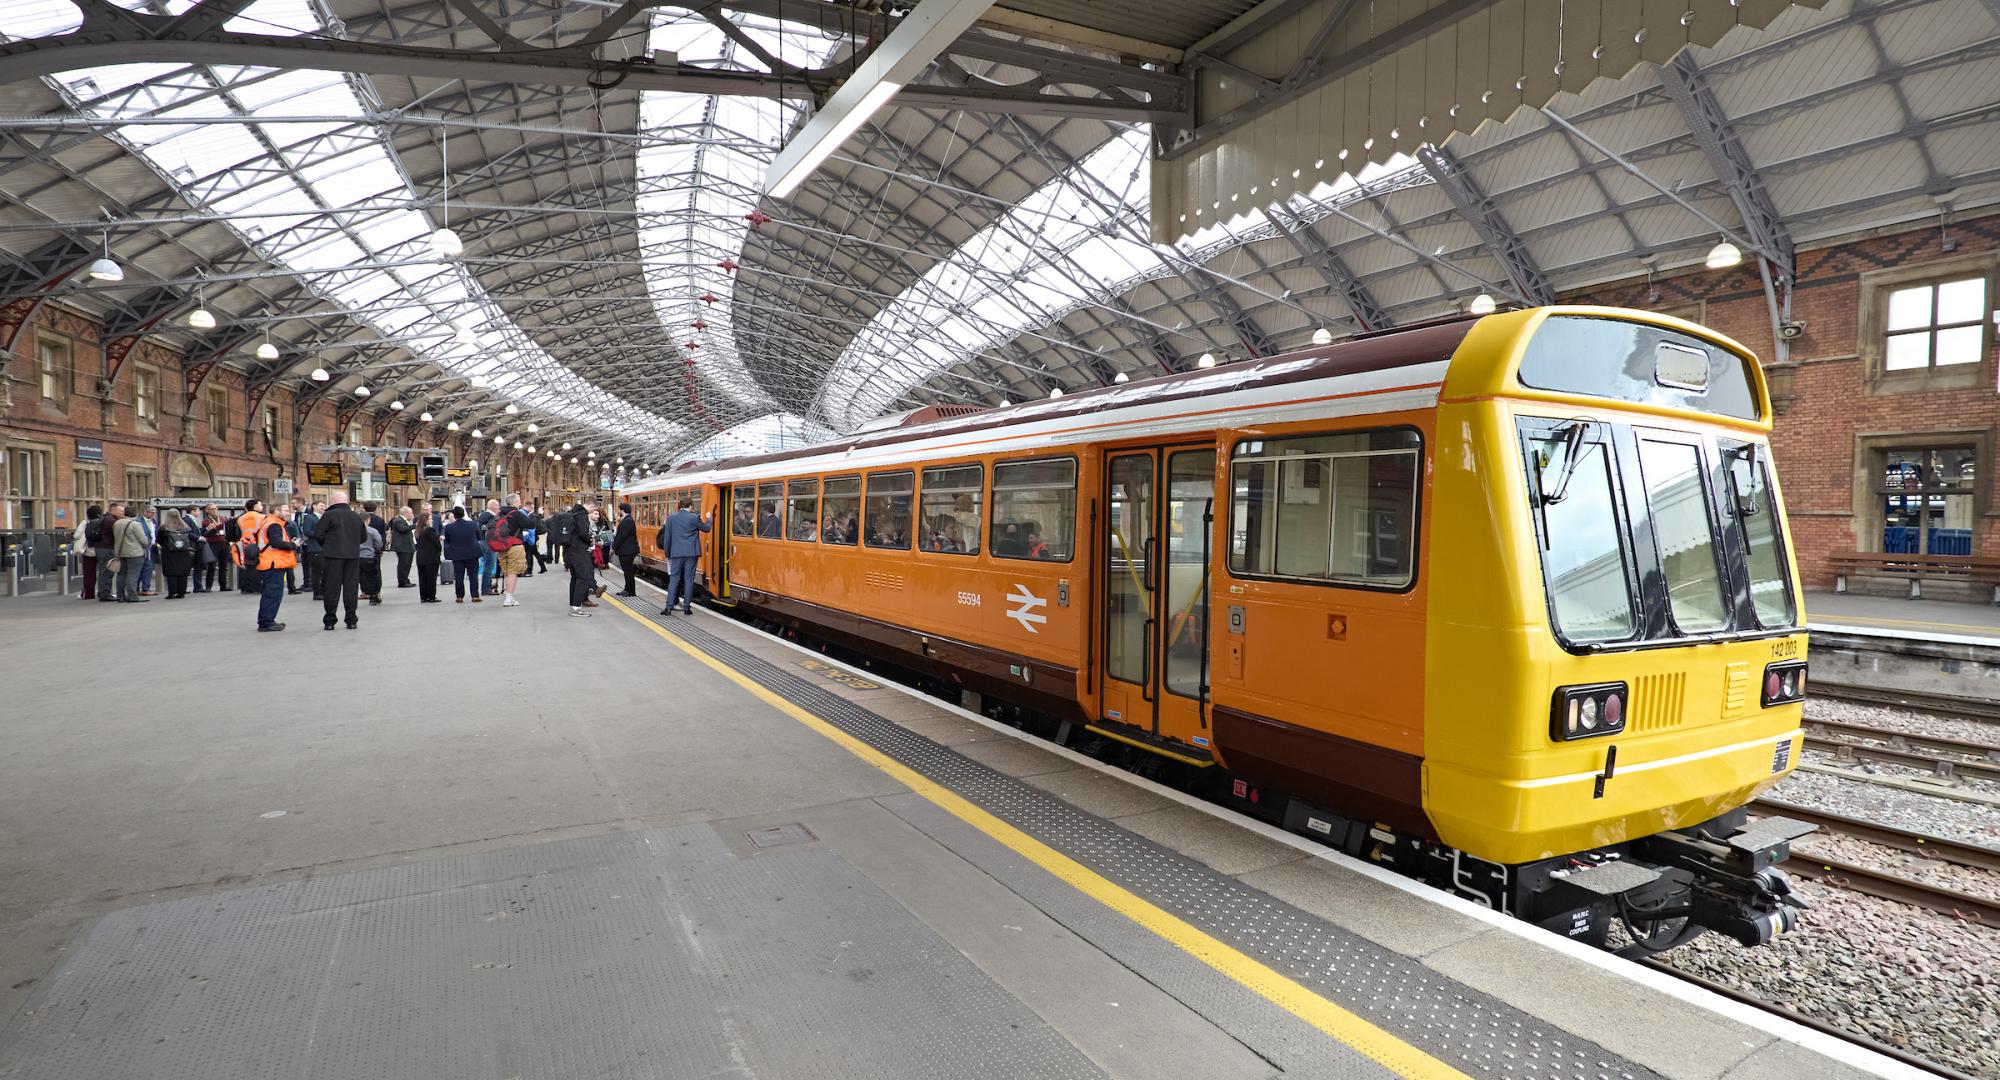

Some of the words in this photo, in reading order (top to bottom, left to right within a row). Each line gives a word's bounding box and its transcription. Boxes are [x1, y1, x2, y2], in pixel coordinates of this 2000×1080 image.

[957, 591, 981, 607] 55594
[1771, 643, 1784, 658] 142
[1785, 640, 1797, 656] 003
